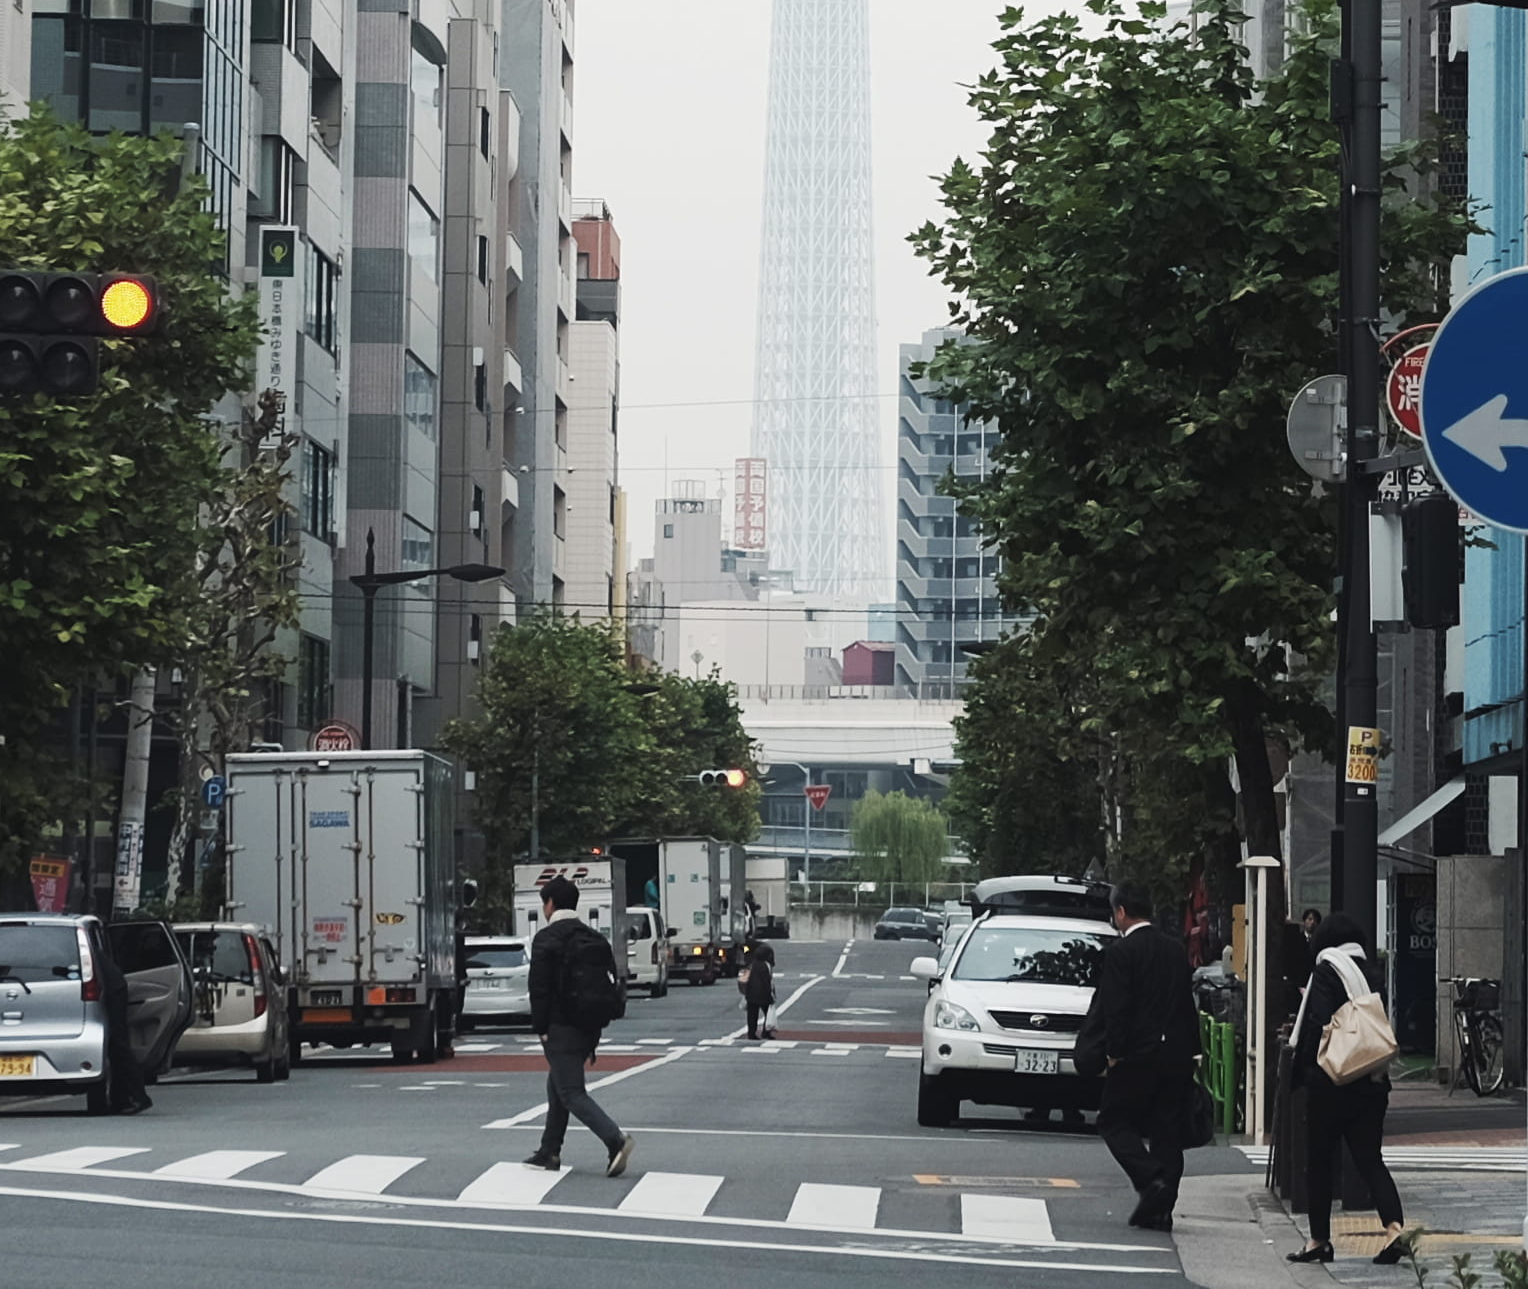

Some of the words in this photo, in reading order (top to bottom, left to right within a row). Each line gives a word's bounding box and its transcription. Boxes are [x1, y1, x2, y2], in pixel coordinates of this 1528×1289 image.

[1361, 731, 1373, 743] P
[208, 783, 221, 806] P
[310, 820, 350, 828] SAGAWA
